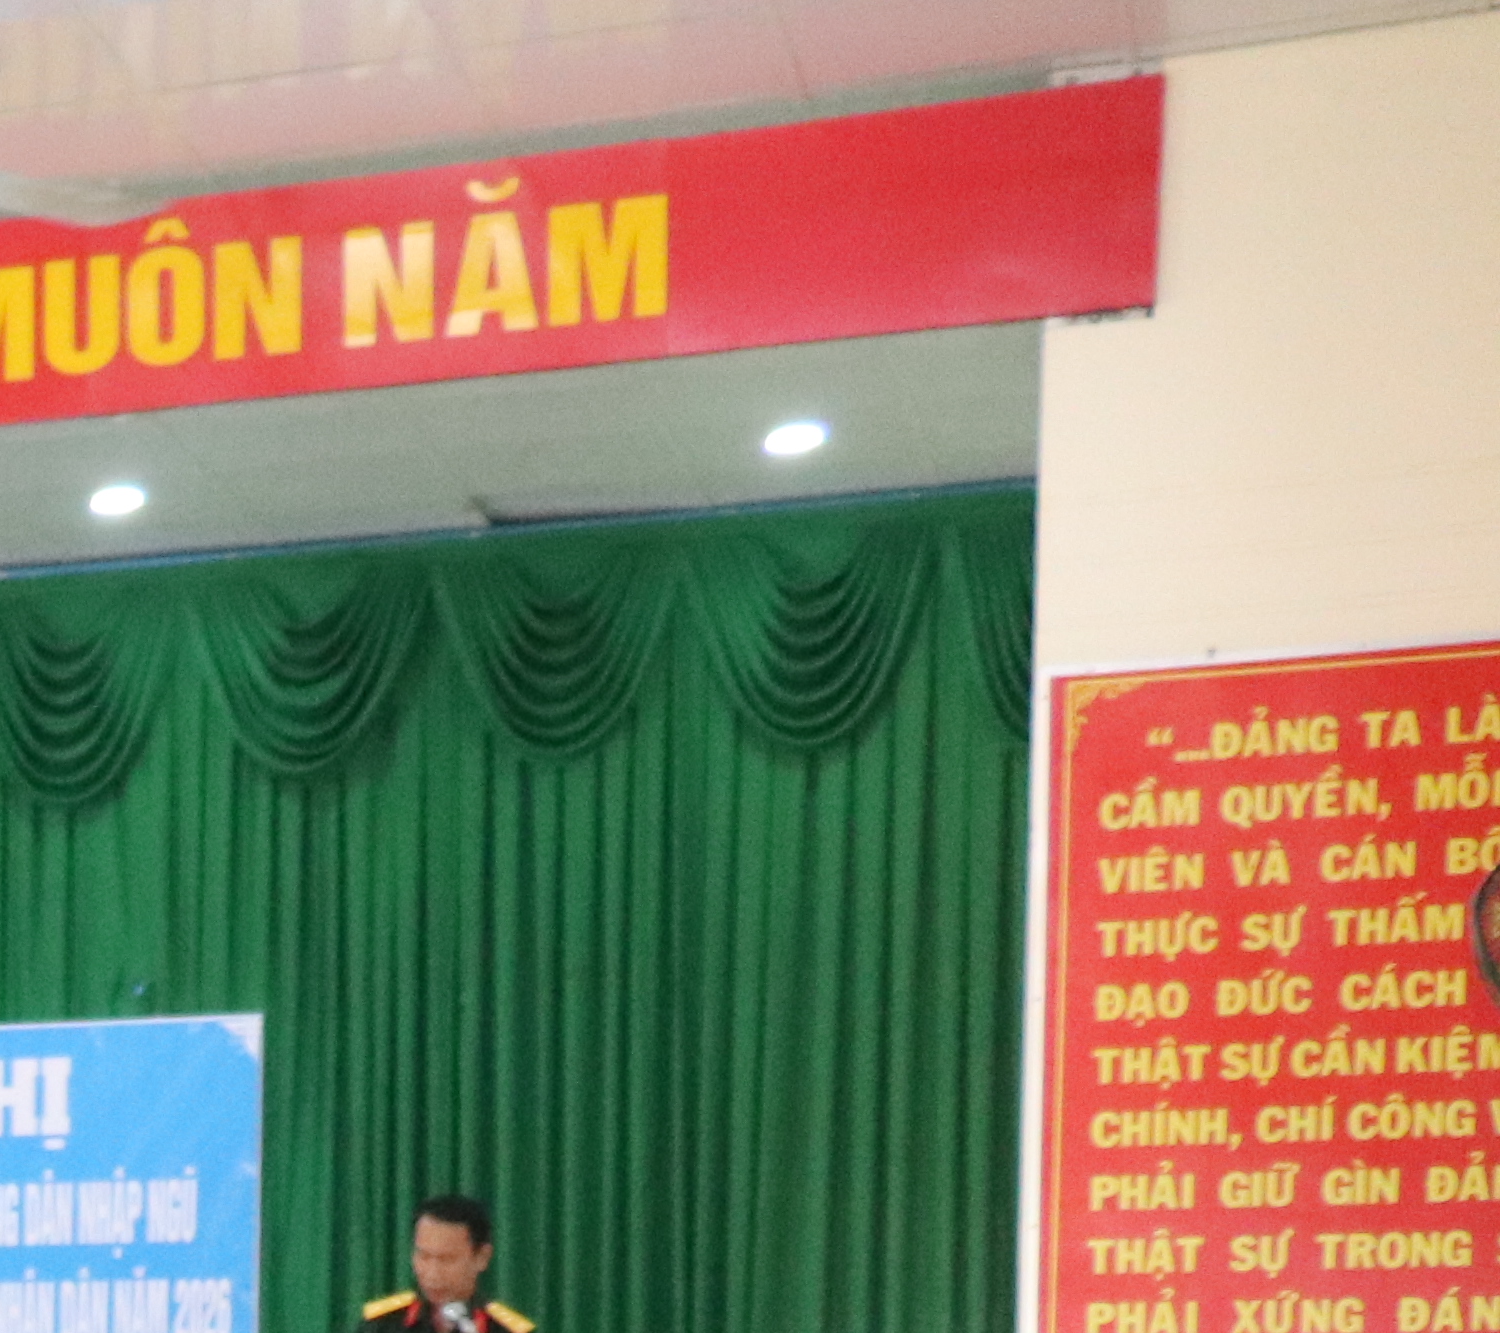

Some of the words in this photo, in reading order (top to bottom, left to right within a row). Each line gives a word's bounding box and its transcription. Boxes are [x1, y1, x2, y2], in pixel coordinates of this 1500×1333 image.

[337, 177, 671, 349] NĂM
[1361, 710, 1420, 748] TA
[1098, 845, 1204, 894] VIÊN
[1231, 839, 1291, 886] VÀ
[1321, 836, 1417, 882] CÁN
[1097, 910, 1219, 963] THỰC
[1241, 906, 1308, 955] SỰ
[1328, 894, 1466, 946] THẤM
[1094, 982, 1189, 1027] ĐẠO
[1216, 969, 1312, 1017] ĐỨC
[1340, 964, 1468, 1010] CÁCH
[1093, 1037, 1211, 1089] THẬT
[1220, 1038, 1283, 1085] SỰ
[1291, 1024, 1386, 1078] CẦN
[1091, 1099, 1242, 1150] CHÍNH,
[1255, 1095, 1337, 1144] CHÍ
[1348, 1094, 1477, 1140] CÔNG
[1090, 1159, 1195, 1210] PHẢI
[1219, 1162, 1300, 1207] GIỮ
[1322, 1160, 1400, 1204] GÌN
[1088, 1230, 1205, 1280] THẬT
[1229, 1230, 1294, 1278] SỰ
[1317, 1230, 1473, 1270] TRONG
